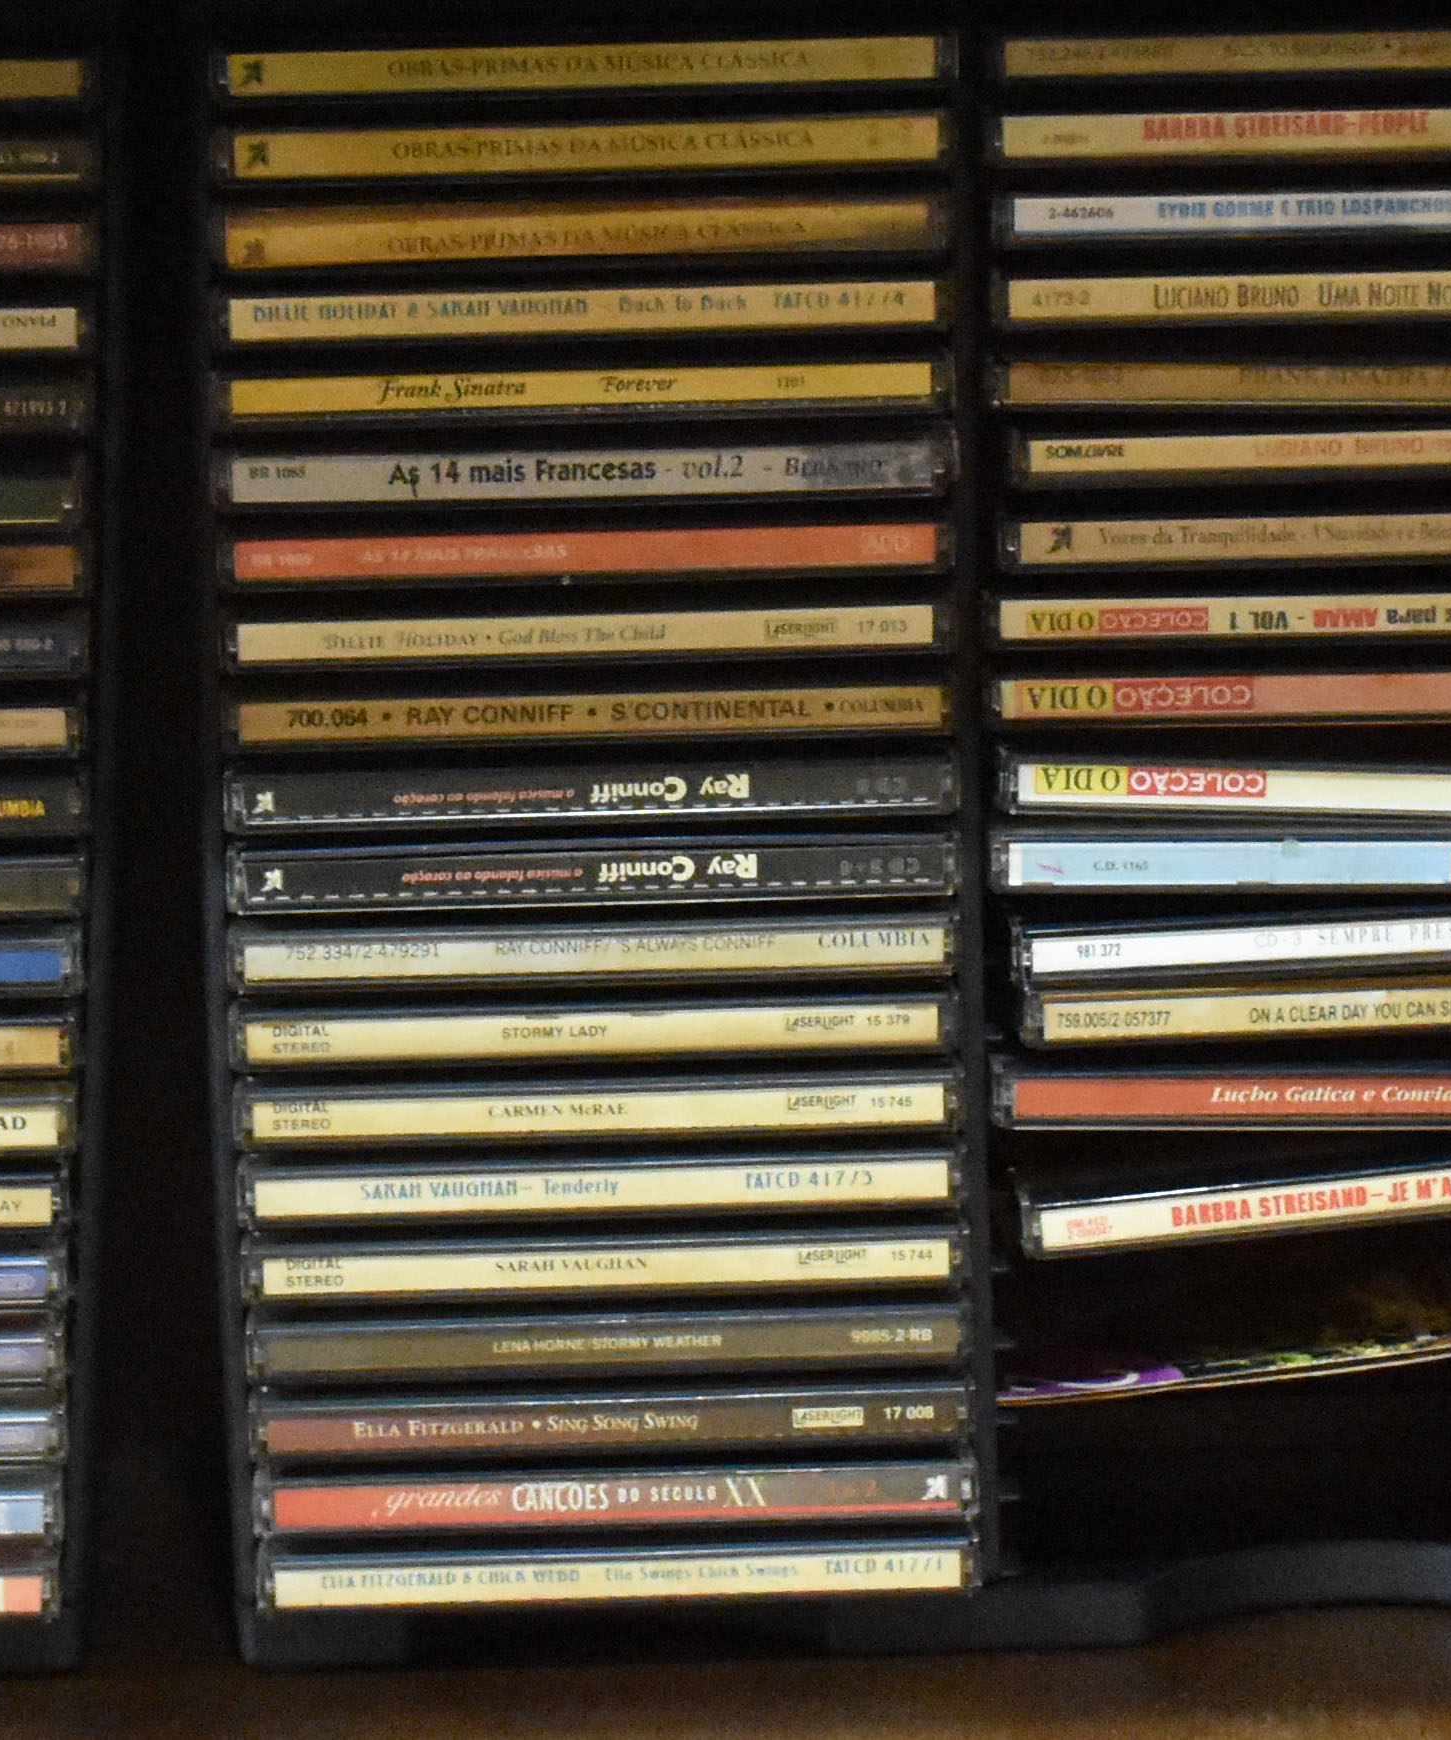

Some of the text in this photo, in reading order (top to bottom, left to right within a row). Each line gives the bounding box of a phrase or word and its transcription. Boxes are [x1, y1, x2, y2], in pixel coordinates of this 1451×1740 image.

[380, 373, 677, 403] Frank Sinatra Forever
[389, 461, 419, 486] As
[431, 461, 458, 485] 14
[469, 459, 526, 484] mais
[536, 457, 656, 482] Francesas
[1028, 683, 1250, 710] COLEÇÃO O DIA
[407, 706, 455, 725] RAY
[463, 703, 572, 724] CONNIFF
[590, 773, 749, 802] Ray Conniff
[1041, 767, 1264, 795] COLEÇÃO O DIA
[818, 932, 930, 949] COLUMBIA
[867, 1015, 881, 1027] 15
[886, 1013, 910, 1025] 379
[1250, 1007, 1271, 1024] ON
[1275, 1006, 1284, 1023] A
[1289, 1005, 1337, 1022] CLEAR
[1341, 1004, 1368, 1021] DAY
[1373, 1002, 1402, 1020] YOU
[1407, 1001, 1437, 1019] CAN
[273, 1025, 329, 1038] DIGITAL
[502, 1024, 607, 1039] STORMY LADY
[272, 1041, 330, 1054] STEREO
[1211, 1086, 1278, 1103] Lucho
[1284, 1086, 1356, 1102] Gatica
[1364, 1089, 1374, 1102] e
[488, 1105, 563, 1118] CARMEN
[273, 1117, 331, 1130] STEREO
[1172, 1203, 1252, 1227] BARBRA
[892, 1249, 905, 1261] 15
[909, 1248, 933, 1261] 744
[285, 1258, 341, 1271] DIGITAL
[495, 1257, 647, 1273] SARAH VAUGHAN
[285, 1275, 344, 1288] STEREO
[654, 1335, 722, 1348] WEATHER
[385, 1486, 502, 1514] grandes
[618, 1486, 639, 1503] DO
[724, 1477, 766, 1507] XX
